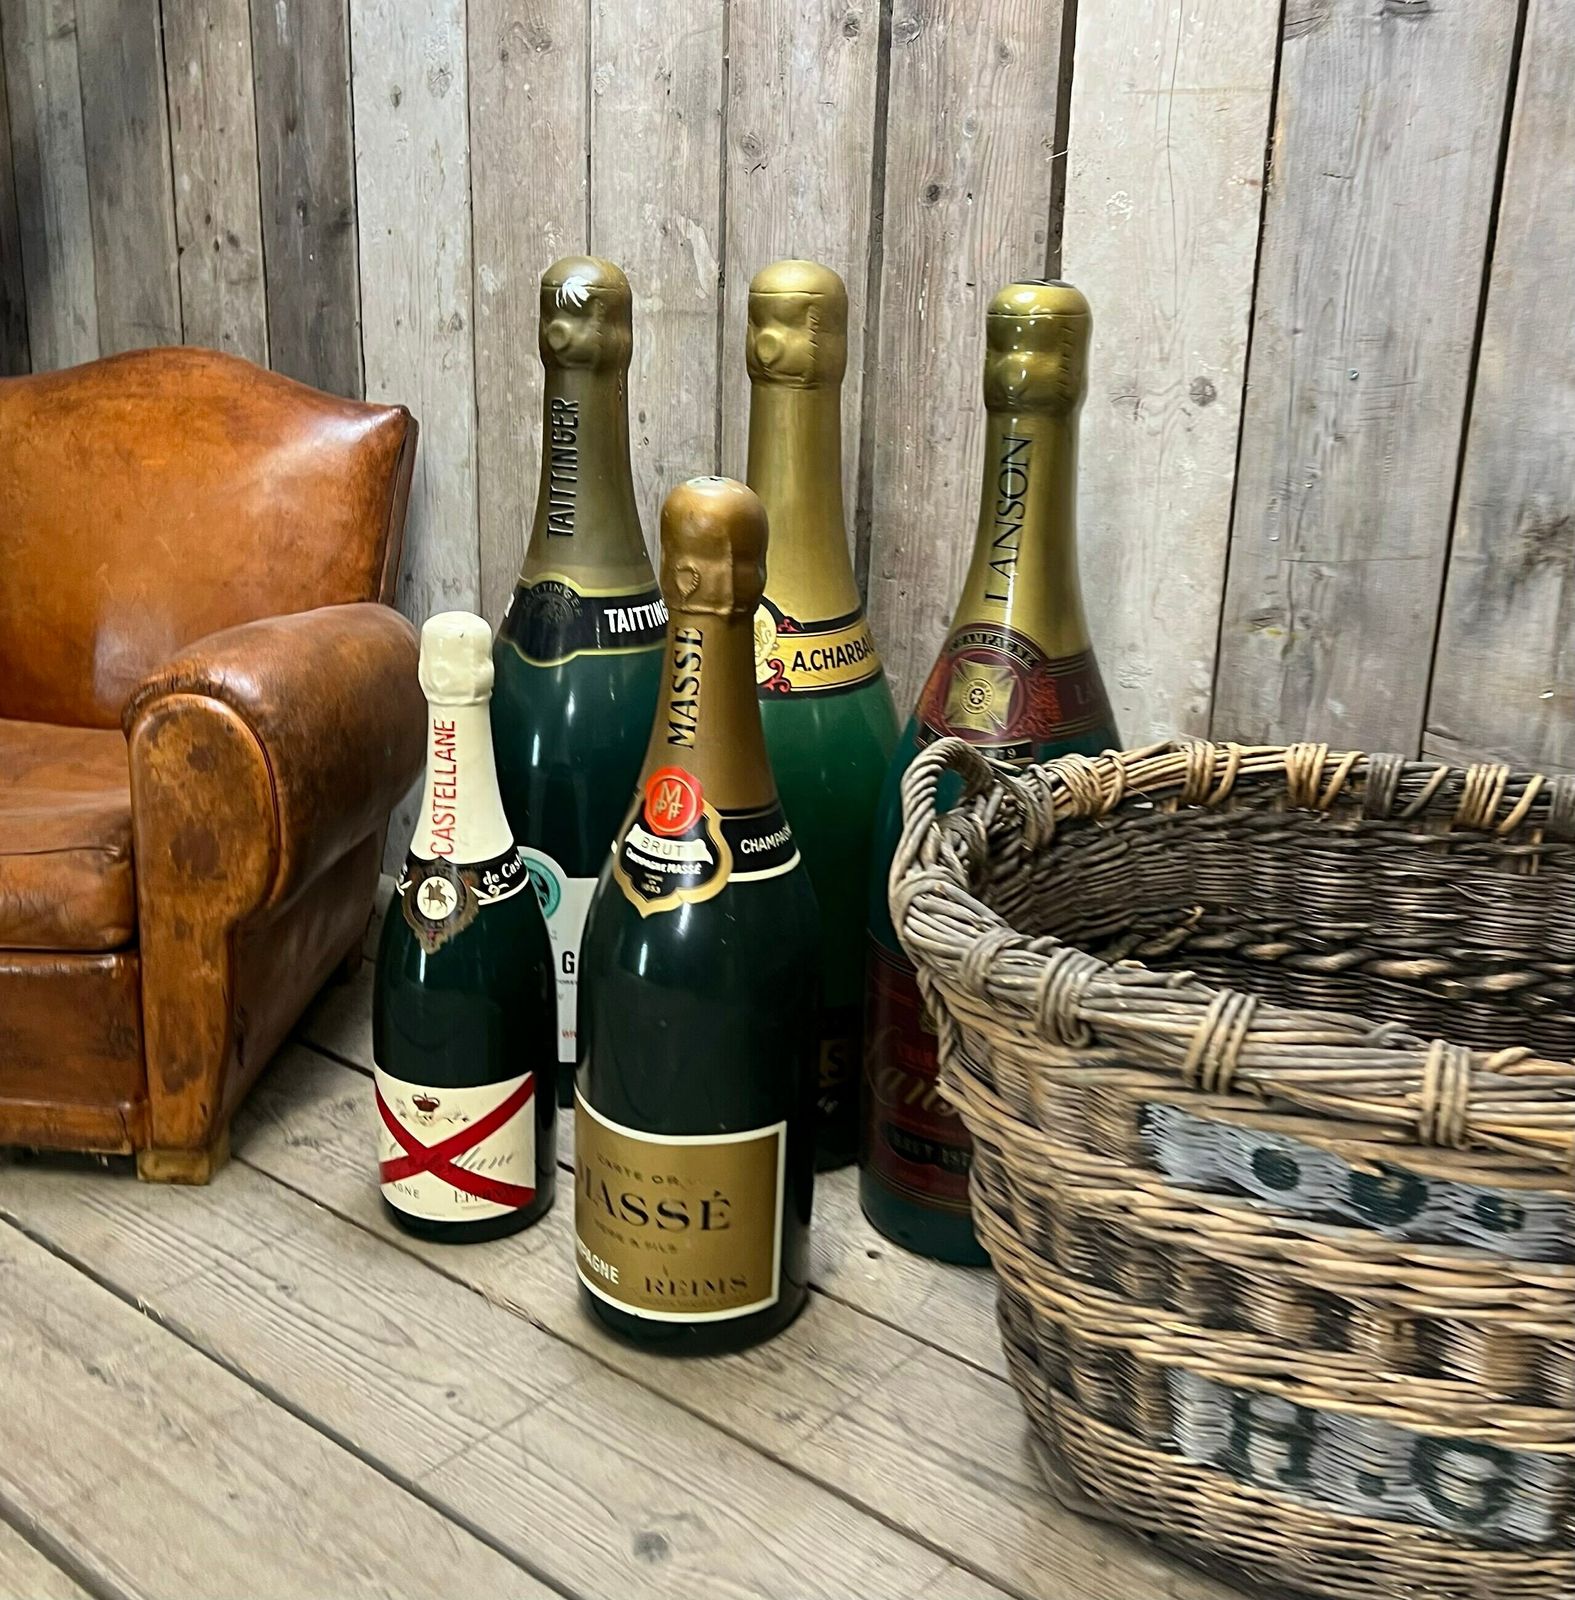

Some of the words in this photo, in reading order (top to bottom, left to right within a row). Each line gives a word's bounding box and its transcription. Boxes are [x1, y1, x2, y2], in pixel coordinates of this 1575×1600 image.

[546, 397, 580, 538] TAITTINGER
[985, 436, 1033, 605] LANSON
[430, 718, 458, 857] CASTELLANE
[482, 870, 500, 886] de
[641, 836, 685, 857] BRUT
[644, 1274, 748, 1297] REIMS
